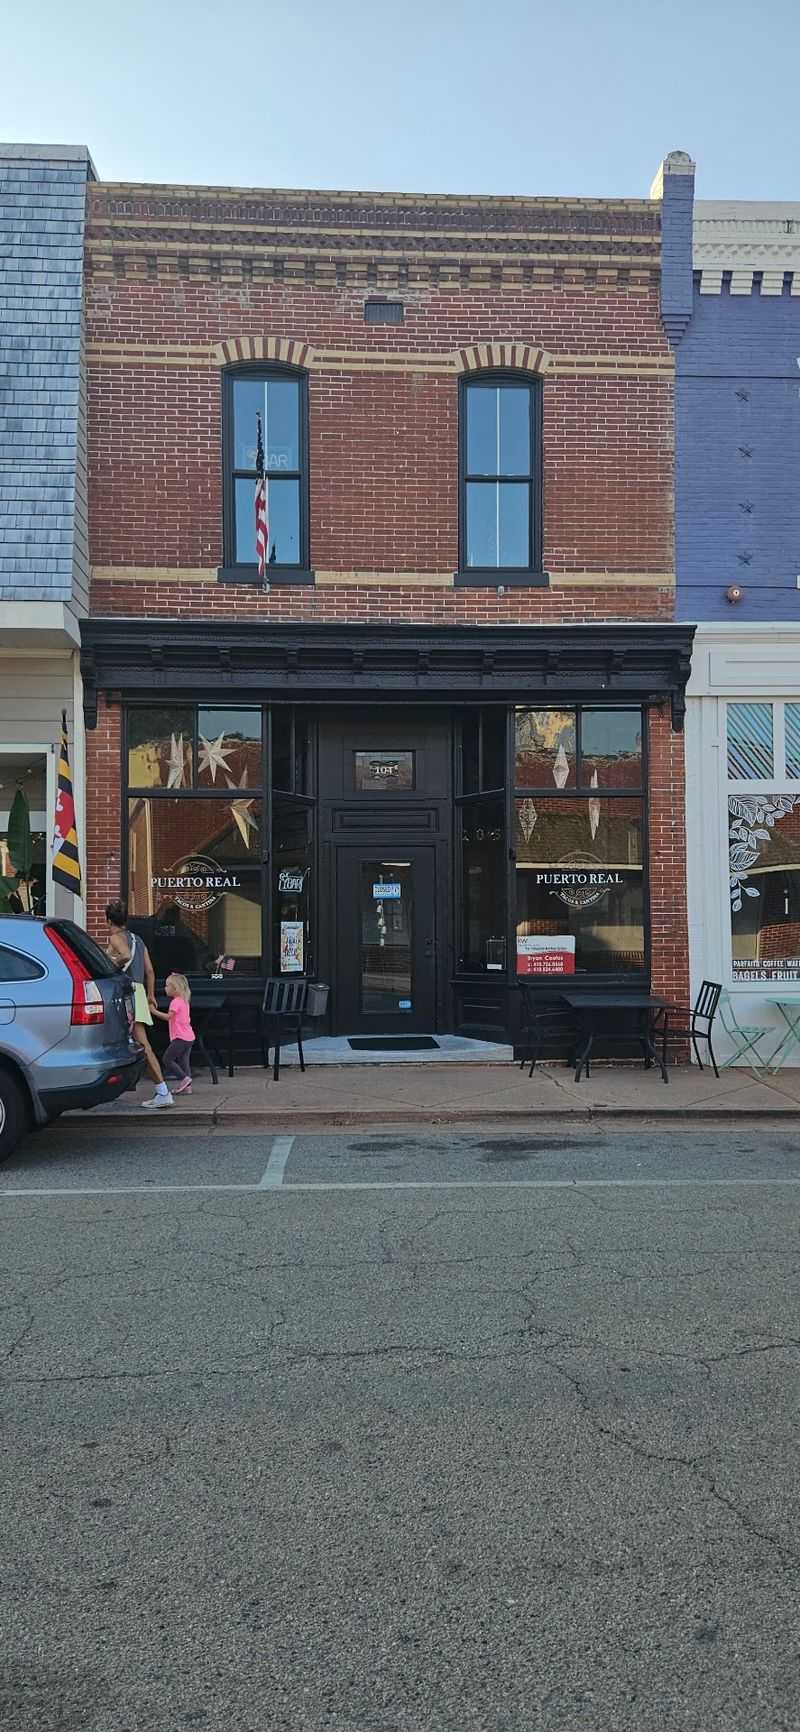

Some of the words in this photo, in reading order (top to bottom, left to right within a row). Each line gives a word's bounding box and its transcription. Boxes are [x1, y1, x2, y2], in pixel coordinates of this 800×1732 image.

[151, 877, 203, 888] PUERTO
[206, 876, 240, 887] REAL
[536, 874, 587, 884] PUERTO
[589, 873, 624, 883] REAL
